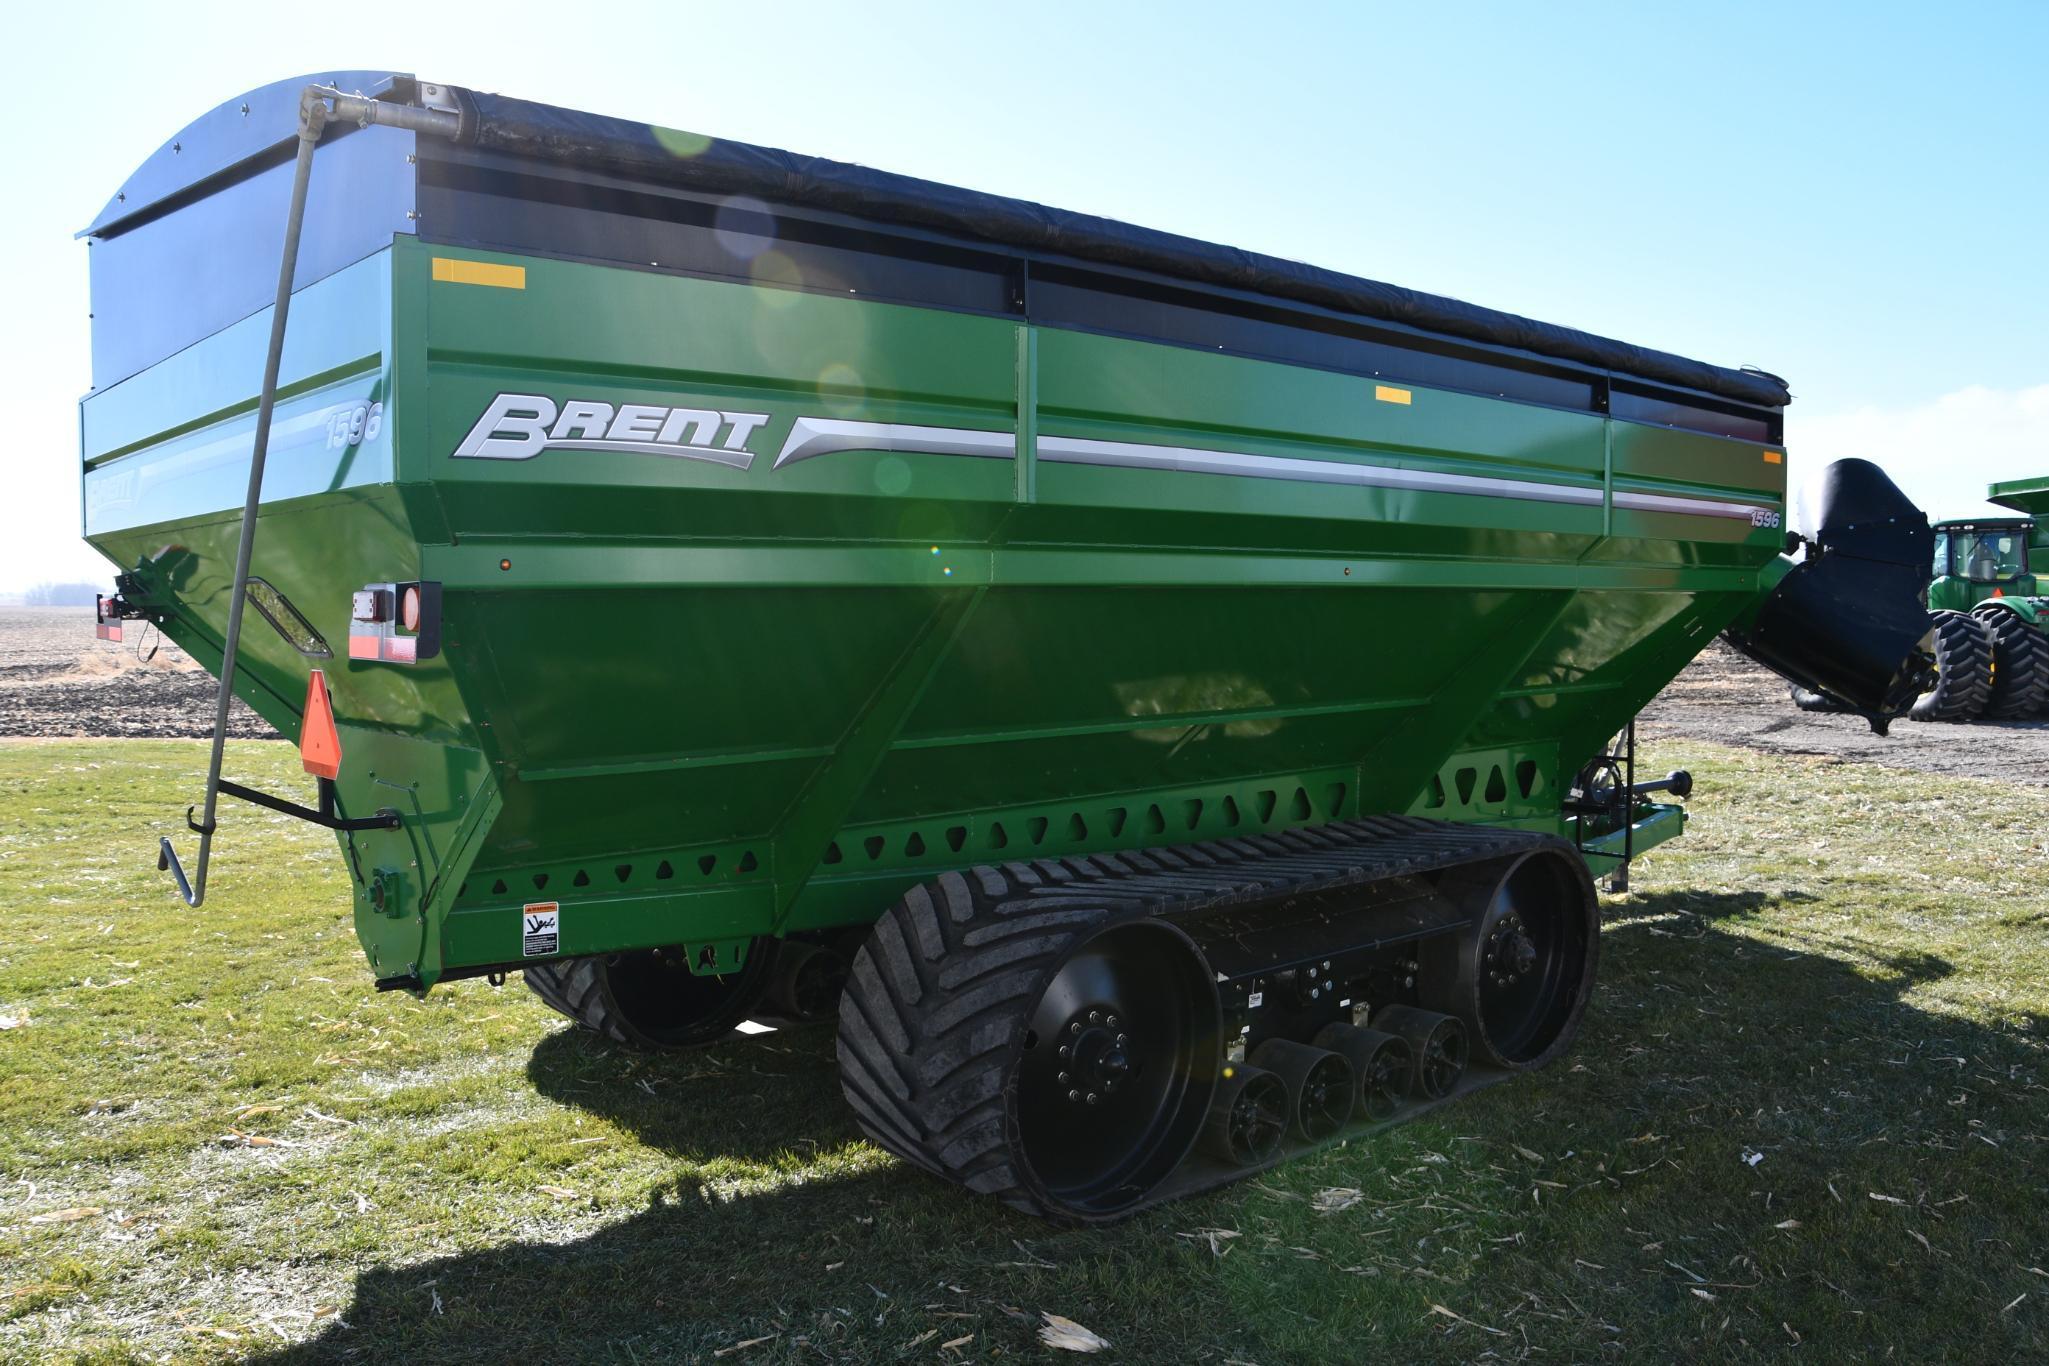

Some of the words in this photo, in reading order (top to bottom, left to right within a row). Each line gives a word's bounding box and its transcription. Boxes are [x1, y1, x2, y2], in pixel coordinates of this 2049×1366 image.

[326, 402, 383, 451] 1596
[450, 391, 771, 461] BRENT
[1750, 510, 1780, 529] 1596
